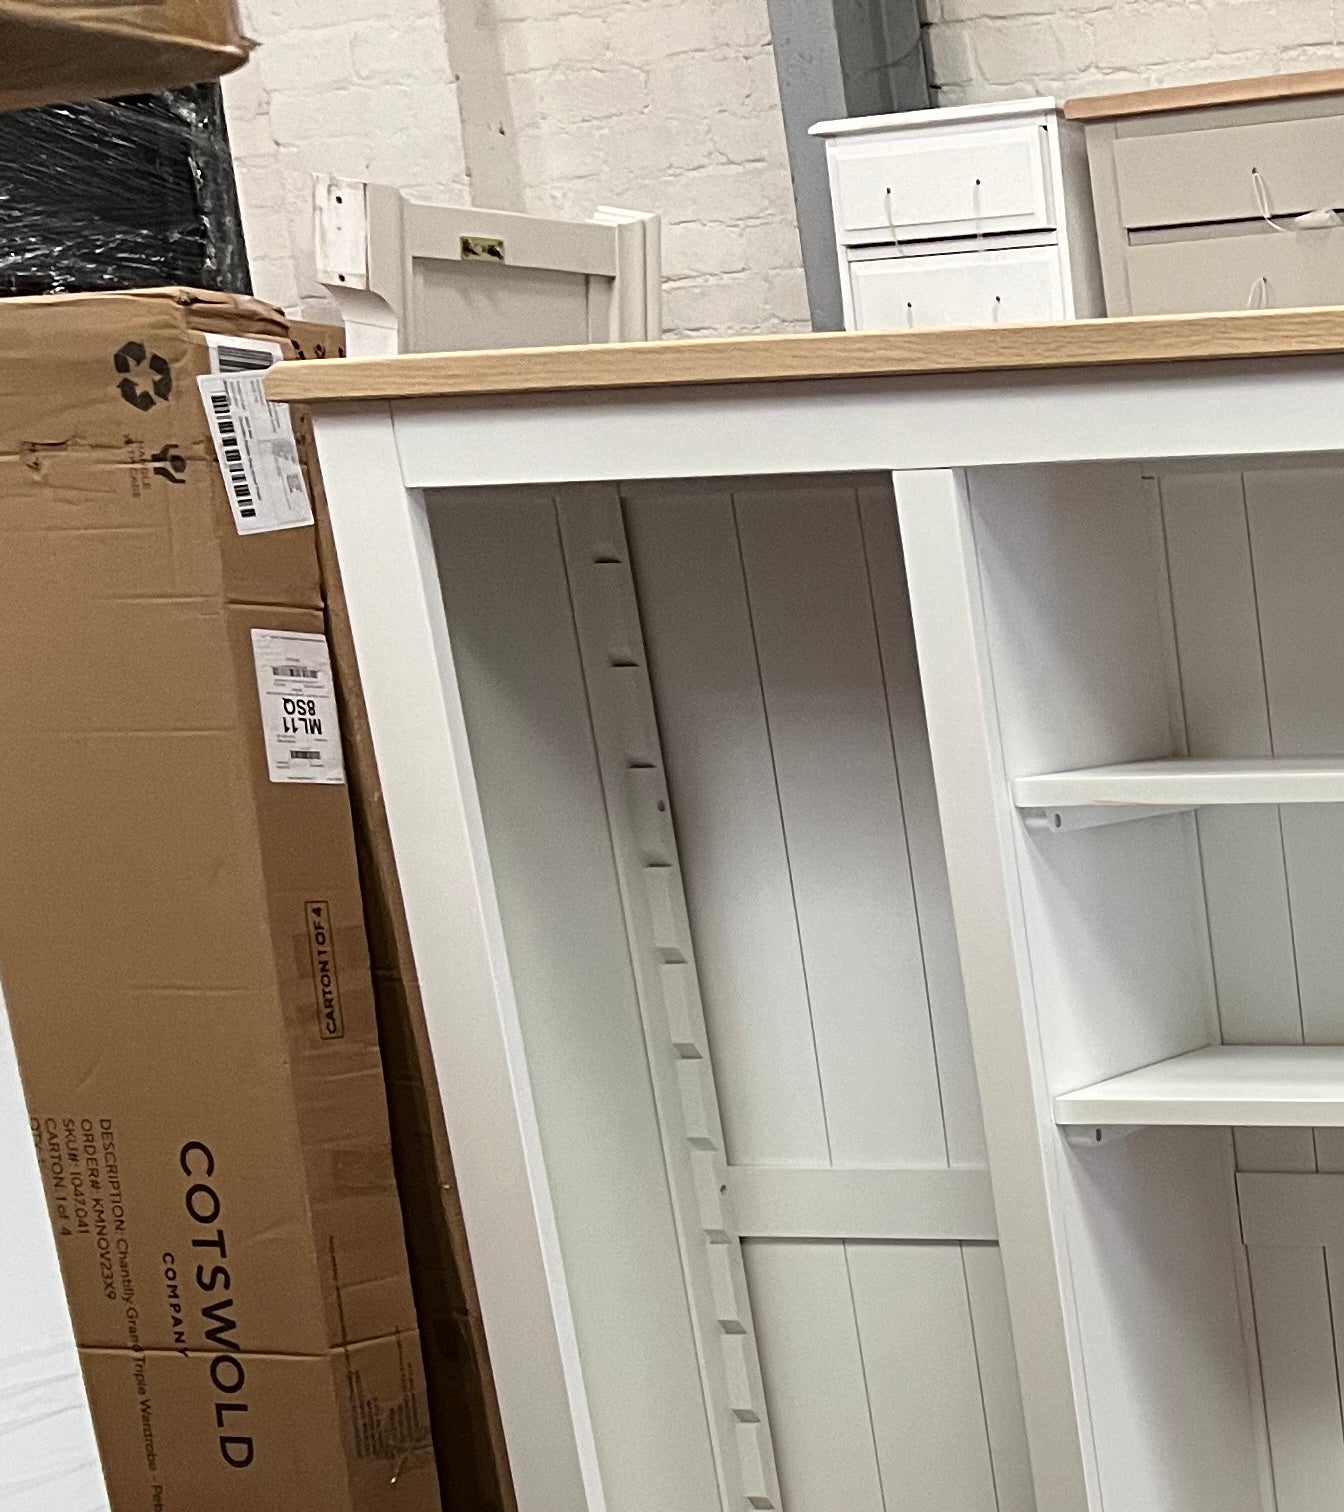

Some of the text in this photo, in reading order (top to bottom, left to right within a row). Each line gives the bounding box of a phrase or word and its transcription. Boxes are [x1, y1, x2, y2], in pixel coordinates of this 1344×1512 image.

[281, 695, 315, 718] 8SQ
[282, 713, 322, 737] ML11
[312, 907, 323, 918] 4
[314, 919, 327, 946] OF
[320, 960, 338, 1035] CARTON
[90, 1196, 117, 1301] KMNOV23X9
[112, 1237, 136, 1304] Chantilly
[160, 1251, 189, 1359] COMPANY
[179, 1140, 256, 1470] COTSWOLD
[130, 1354, 151, 1396] Triple
[137, 1397, 161, 1472] Wardrobe
